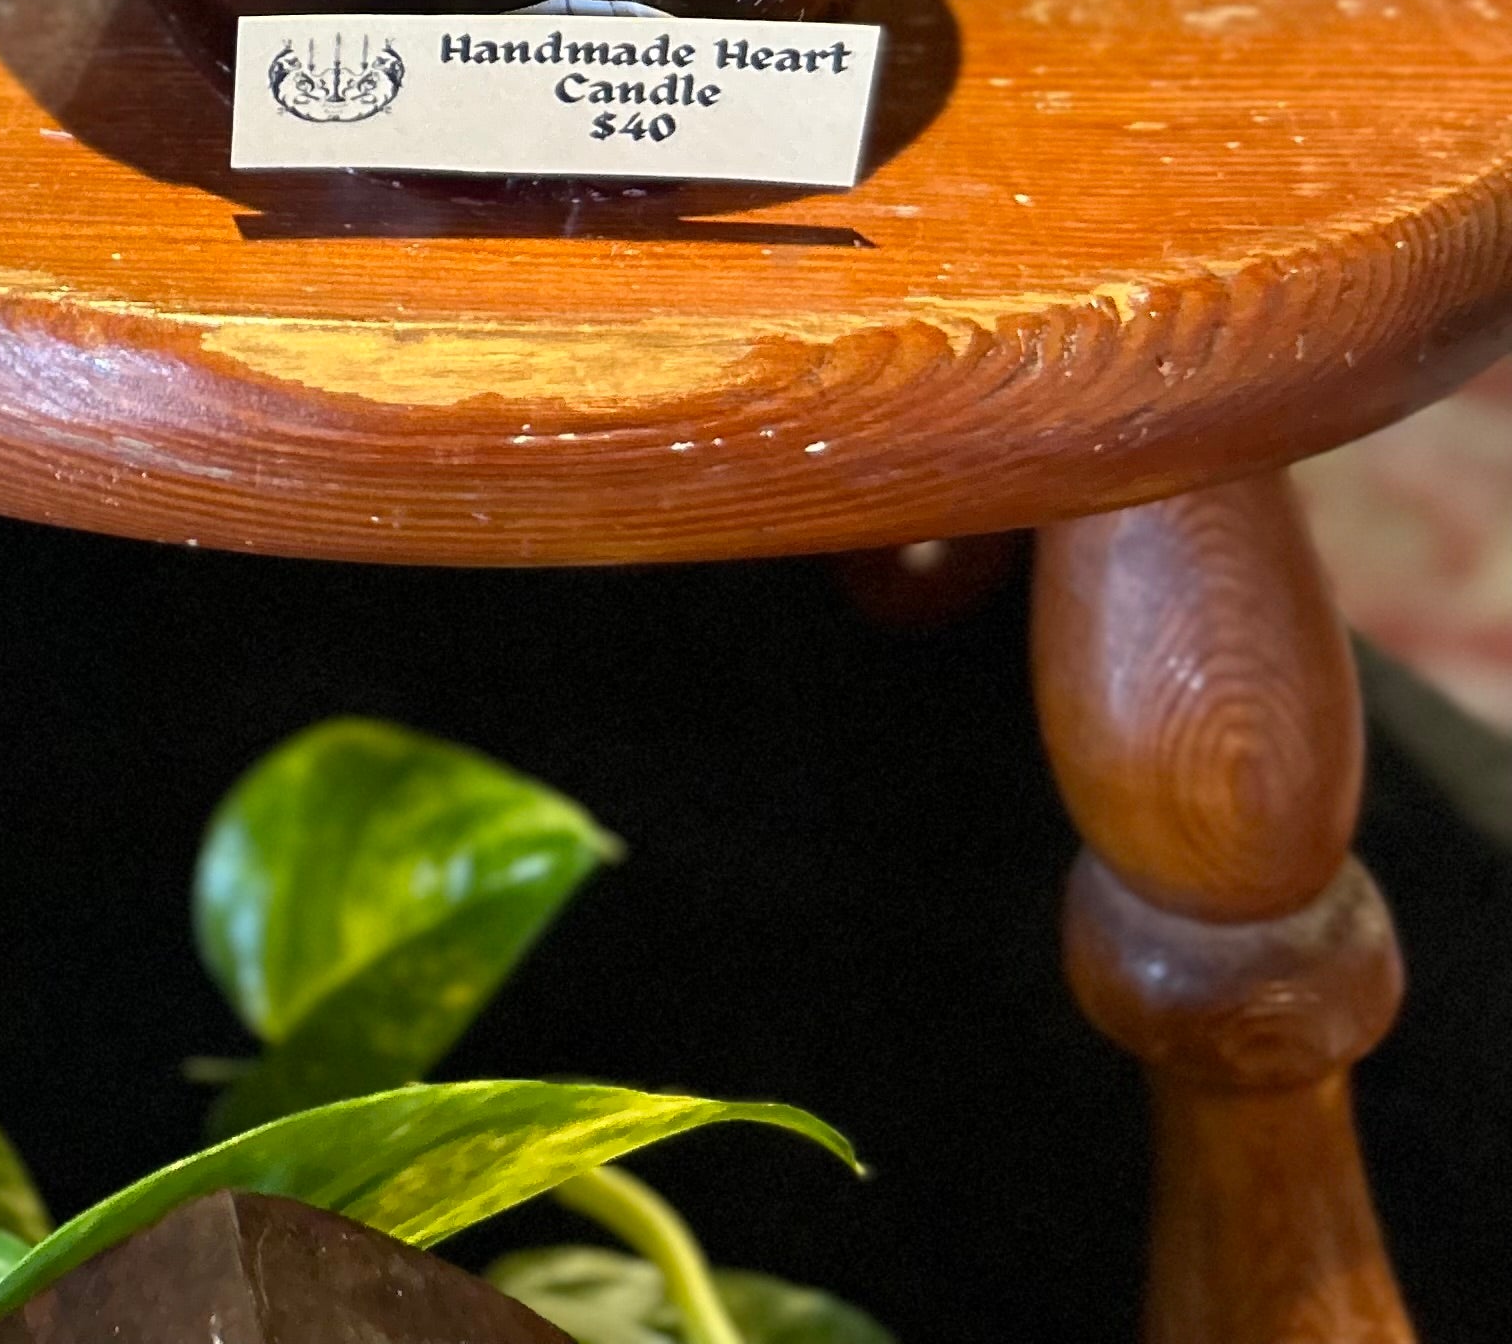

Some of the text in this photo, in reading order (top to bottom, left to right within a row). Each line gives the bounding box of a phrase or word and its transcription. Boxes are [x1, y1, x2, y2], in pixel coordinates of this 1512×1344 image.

[440, 31, 851, 74] Handmade Heart
[555, 73, 722, 107] Candle
[589, 111, 677, 142] $40
